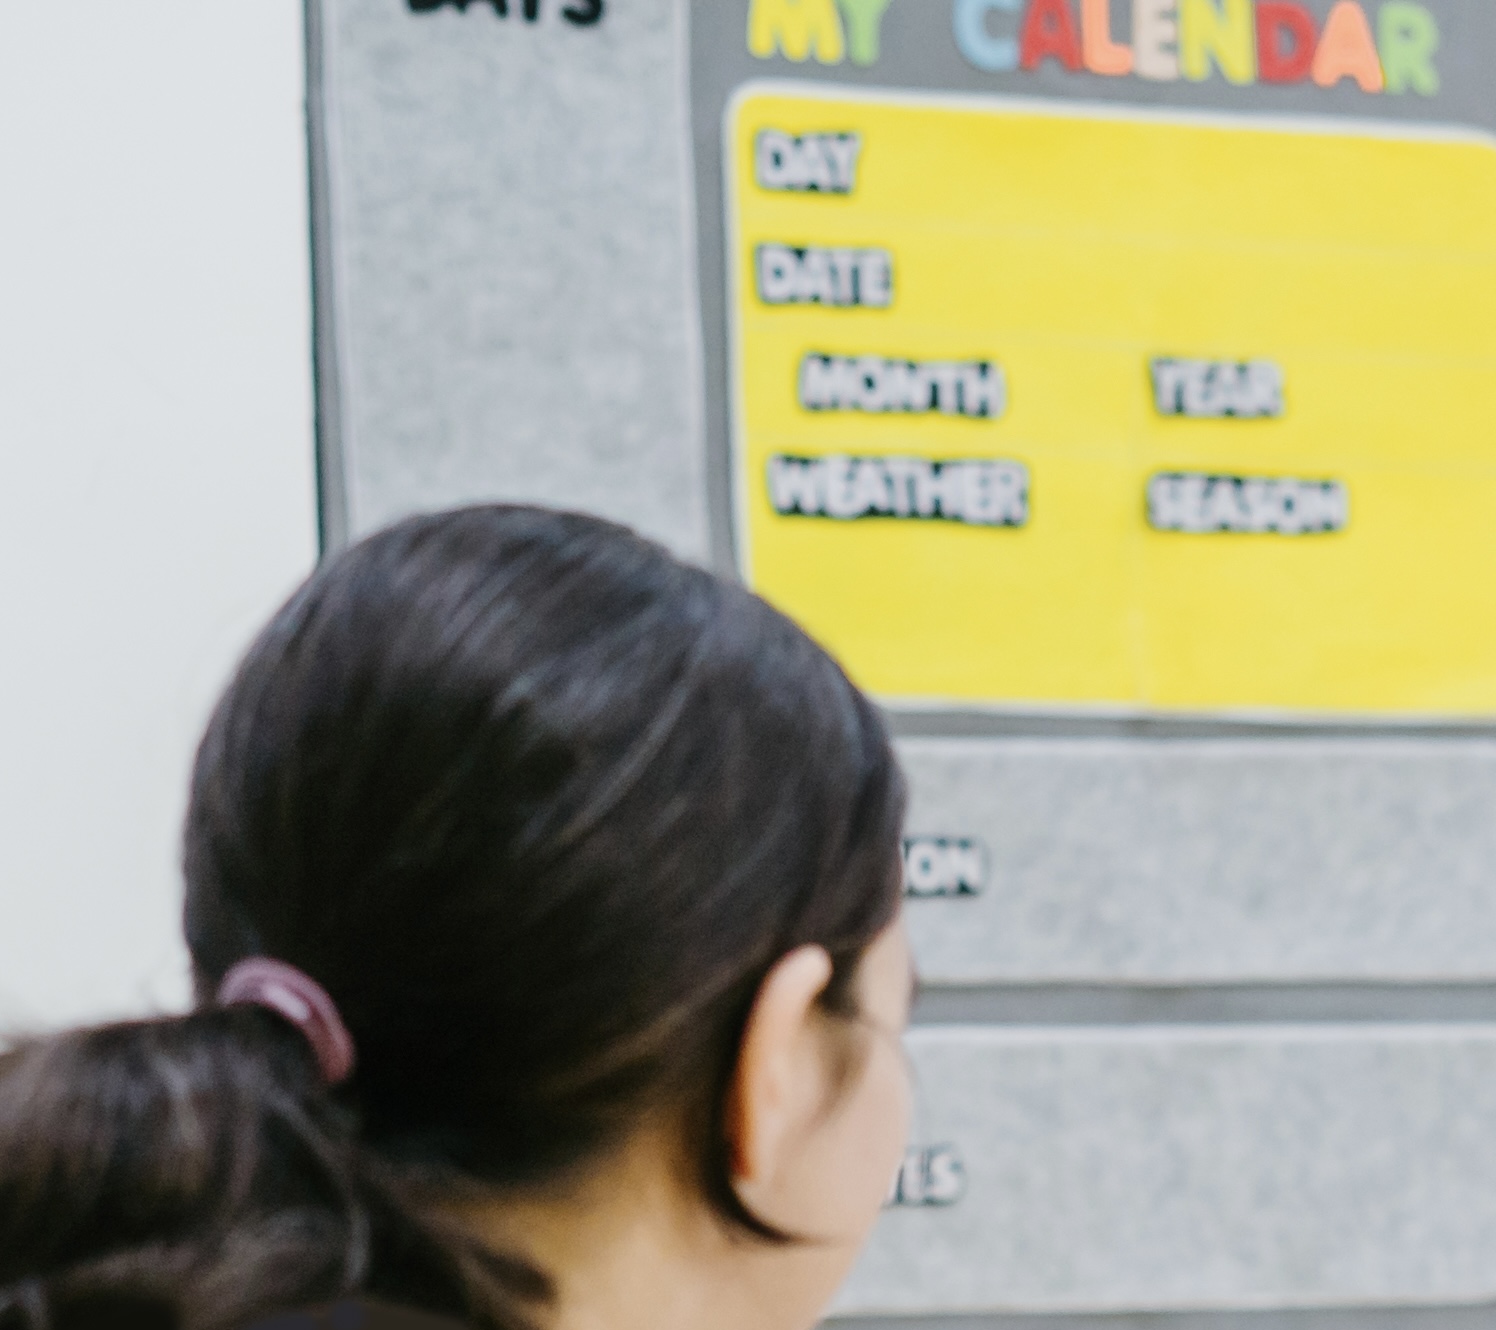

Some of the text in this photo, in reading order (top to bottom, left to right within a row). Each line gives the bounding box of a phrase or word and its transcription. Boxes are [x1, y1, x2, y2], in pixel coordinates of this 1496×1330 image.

[747, 0, 1440, 95] MY CALENDAR
[756, 130, 860, 196] DAY
[756, 242, 894, 308] DATE
[798, 350, 1284, 420] MONTH YEAR
[768, 452, 1346, 534] WEATHER SEASON
[902, 834, 984, 898] ON
